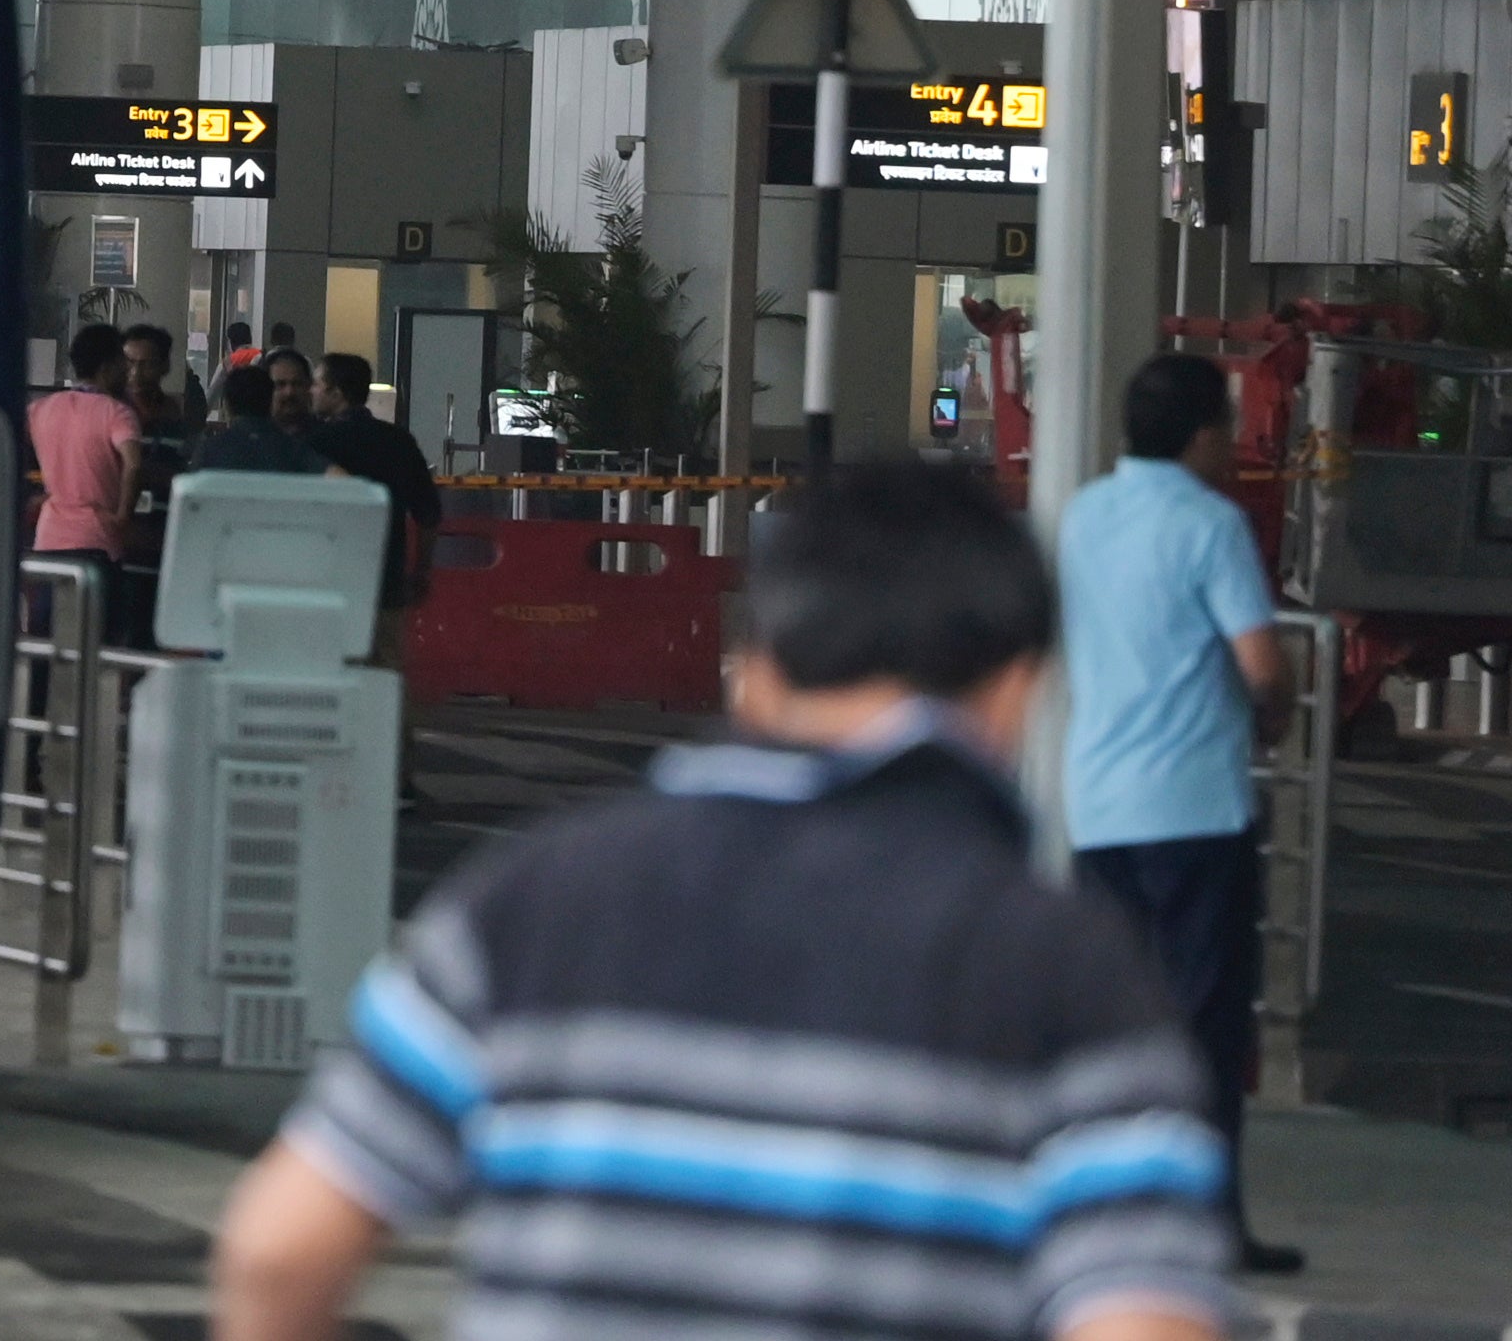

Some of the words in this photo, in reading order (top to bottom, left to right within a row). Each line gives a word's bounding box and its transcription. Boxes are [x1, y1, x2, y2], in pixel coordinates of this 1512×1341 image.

[910, 83, 964, 104] Entry
[967, 83, 998, 126] 4
[128, 106, 170, 124] Entry
[172, 107, 193, 140] 3
[71, 152, 116, 167] Airline
[117, 153, 159, 169] Ticket
[162, 155, 196, 170] Desk
[850, 139, 907, 157] Airline
[907, 141, 960, 159] Ticket
[962, 144, 1005, 161] Desk
[405, 226, 424, 251] D
[1005, 228, 1028, 257] D
